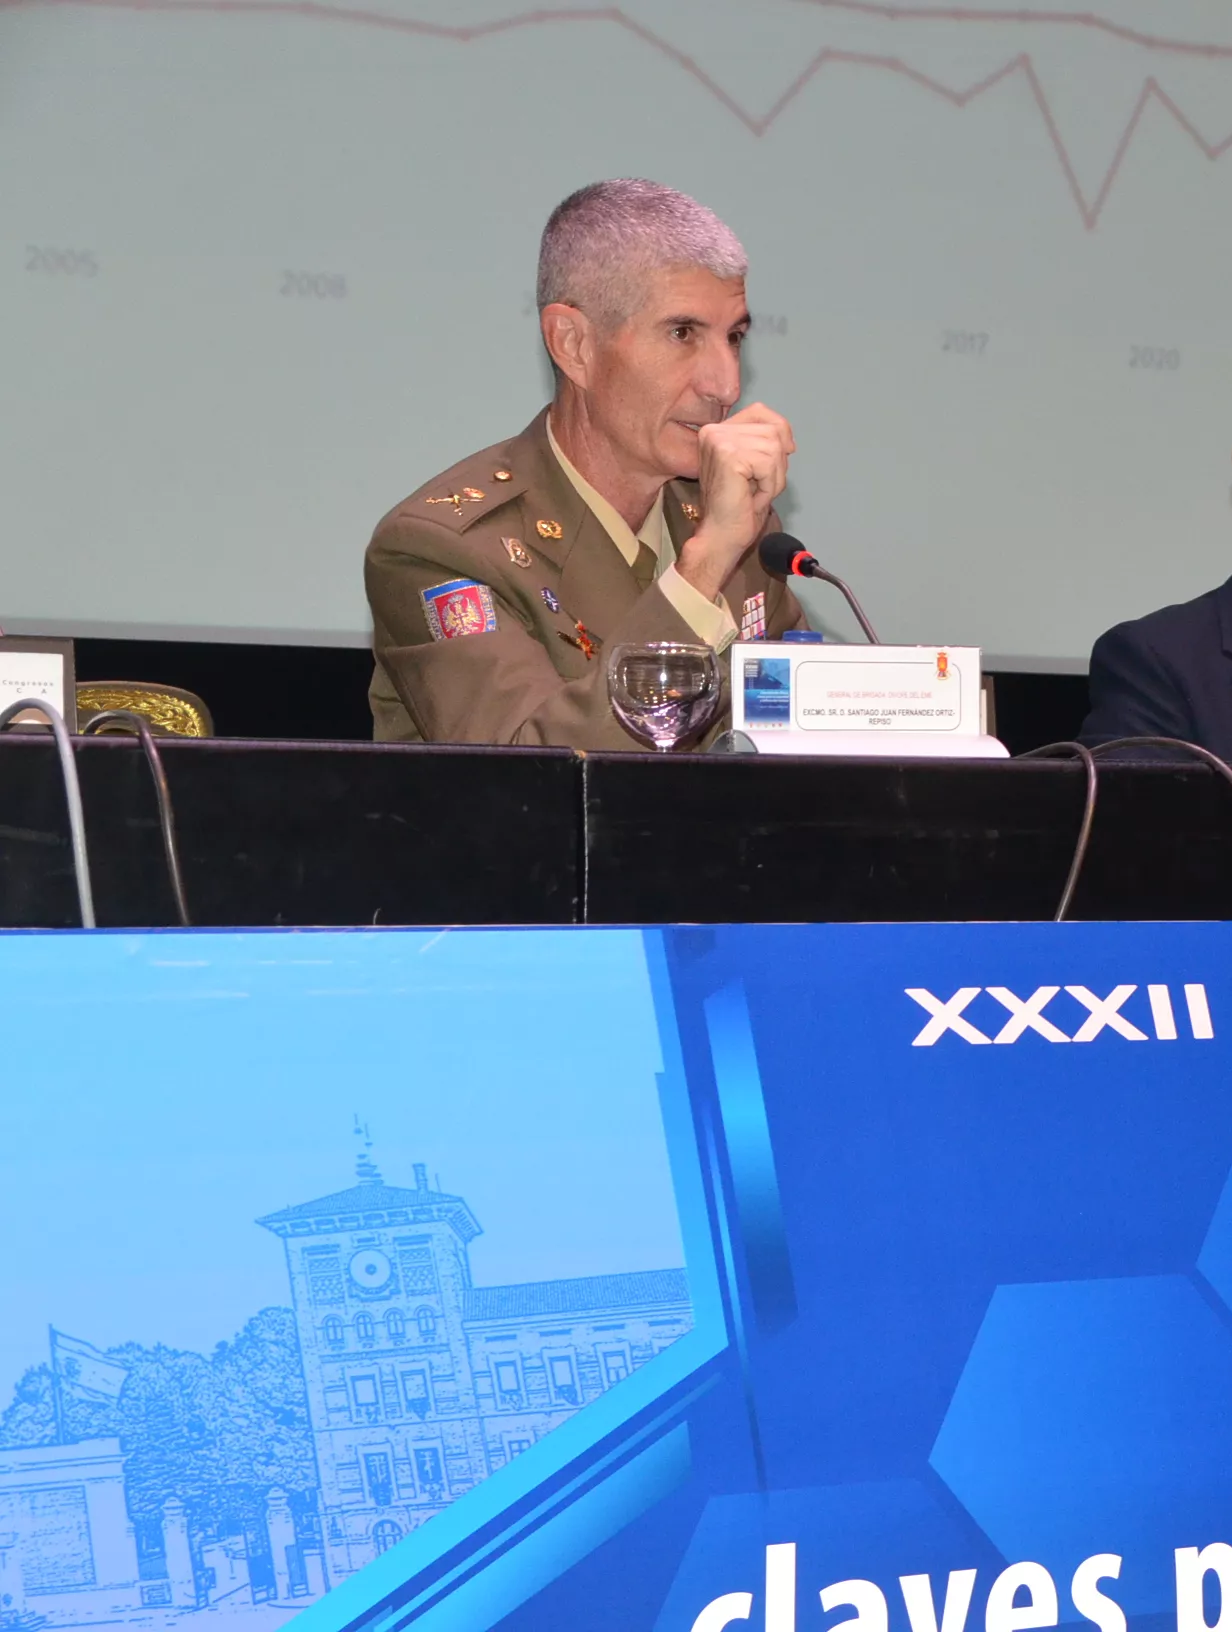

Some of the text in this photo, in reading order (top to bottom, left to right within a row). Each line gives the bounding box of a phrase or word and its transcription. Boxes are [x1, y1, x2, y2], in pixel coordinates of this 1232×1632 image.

[941, 329, 989, 356] 2017
[1128, 344, 1181, 371] 2020
[847, 708, 879, 716] SANTIAGO
[880, 708, 897, 716] JUAN
[868, 717, 892, 725] REPISO
[904, 983, 1214, 1047] XXXII
